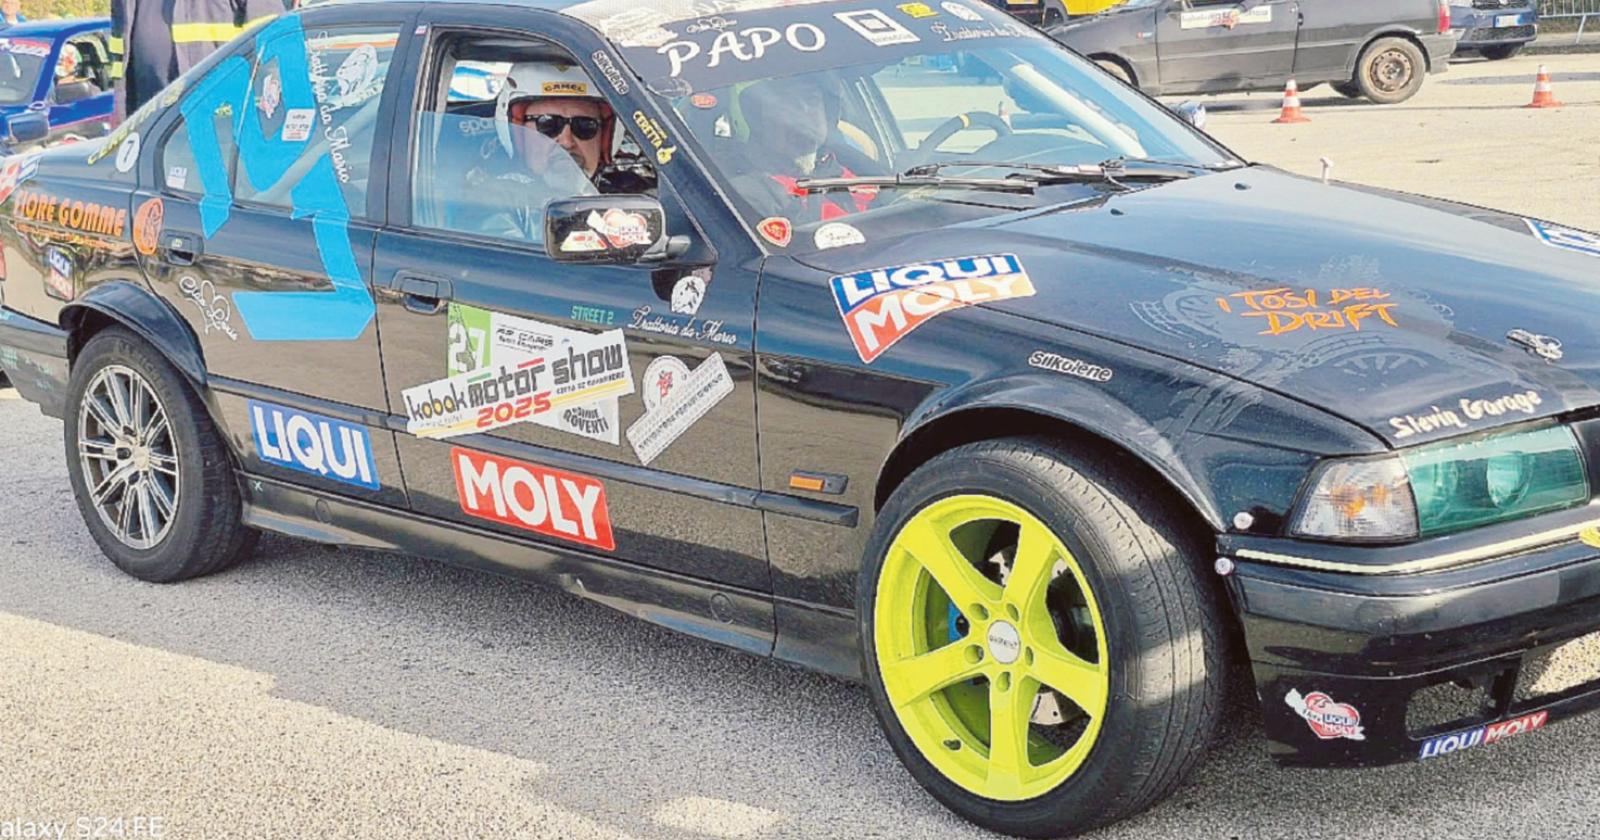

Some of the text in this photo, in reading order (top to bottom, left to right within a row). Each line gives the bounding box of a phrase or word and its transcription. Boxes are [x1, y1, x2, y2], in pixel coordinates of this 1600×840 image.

[656, 23, 826, 77] PAPO
[543, 83, 585, 93] CAMEL
[123, 140, 135, 163] 7
[325, 126, 352, 183] Mario
[59, 199, 127, 237] GOMME
[841, 257, 1013, 305] LIQUI
[1229, 287, 1318, 312] TOSI
[1328, 288, 1391, 305] DEL
[571, 305, 614, 325] STREET 2
[627, 305, 737, 345] Trattoria da Mario
[854, 275, 1020, 352] MOLY
[1240, 302, 1398, 336] DRIFT
[406, 382, 468, 422] kobak
[468, 364, 546, 409] motor
[551, 344, 624, 386] show
[1030, 352, 1111, 381] Silkolene
[476, 391, 552, 429] 2025
[1389, 391, 1542, 439] Slevin Garage
[253, 405, 372, 484] LIQUI
[458, 454, 601, 541] MOLY
[1420, 714, 1542, 759] LIQUI MOLY
